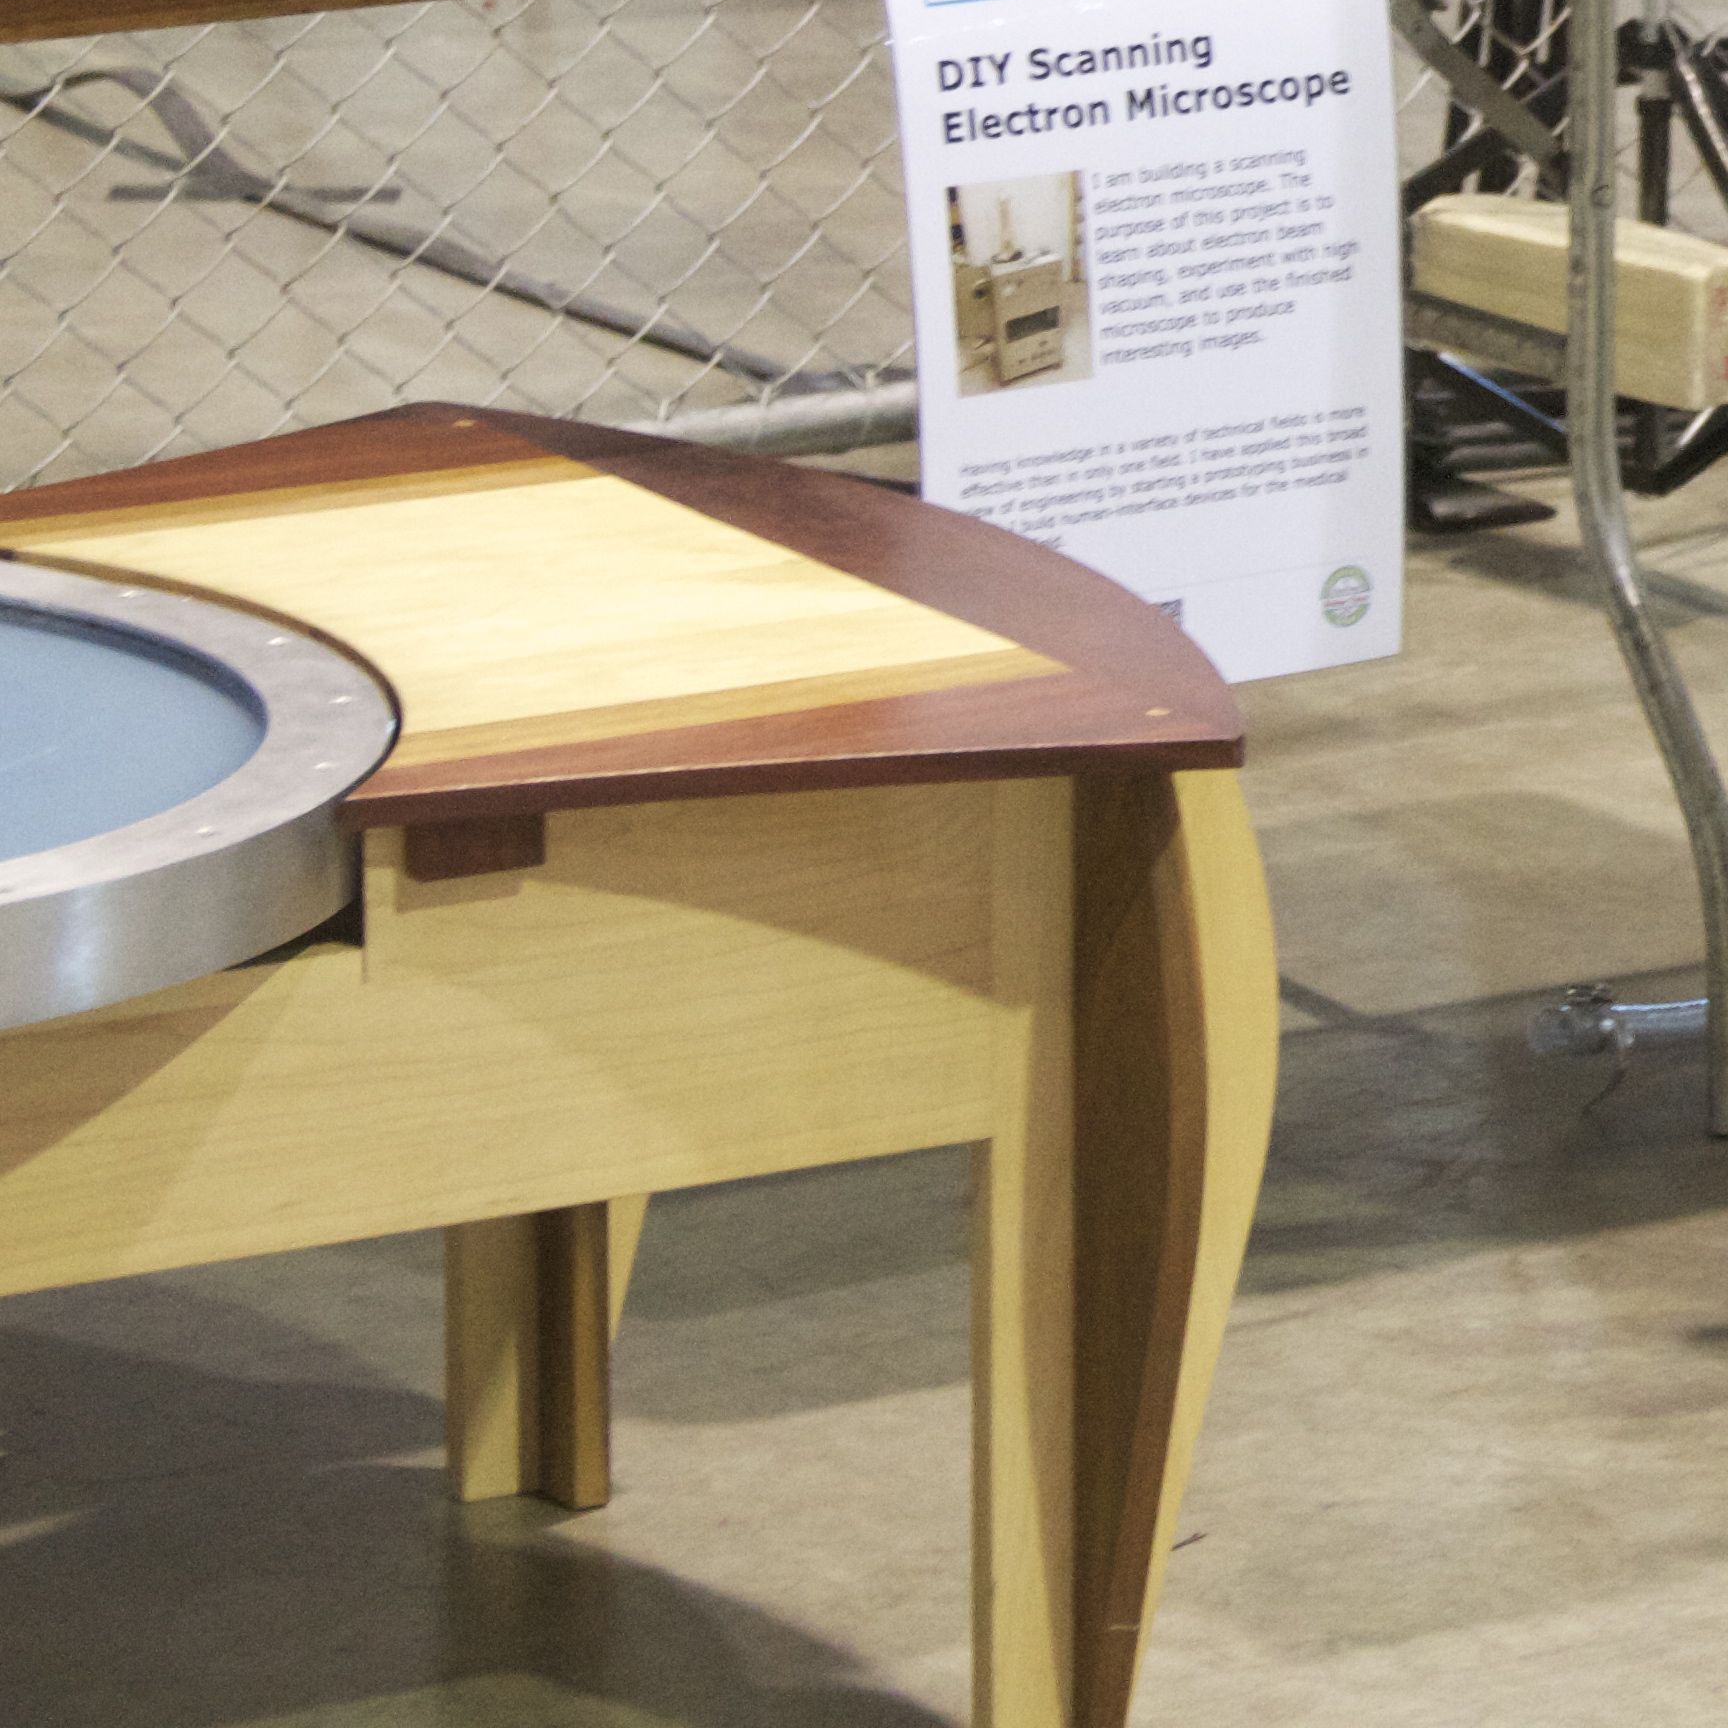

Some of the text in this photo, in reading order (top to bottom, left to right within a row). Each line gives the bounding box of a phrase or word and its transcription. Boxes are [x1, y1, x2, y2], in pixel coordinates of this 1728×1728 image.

[938, 32, 1212, 92] DIY Scanning
[943, 70, 1350, 144] Electron Microscope
